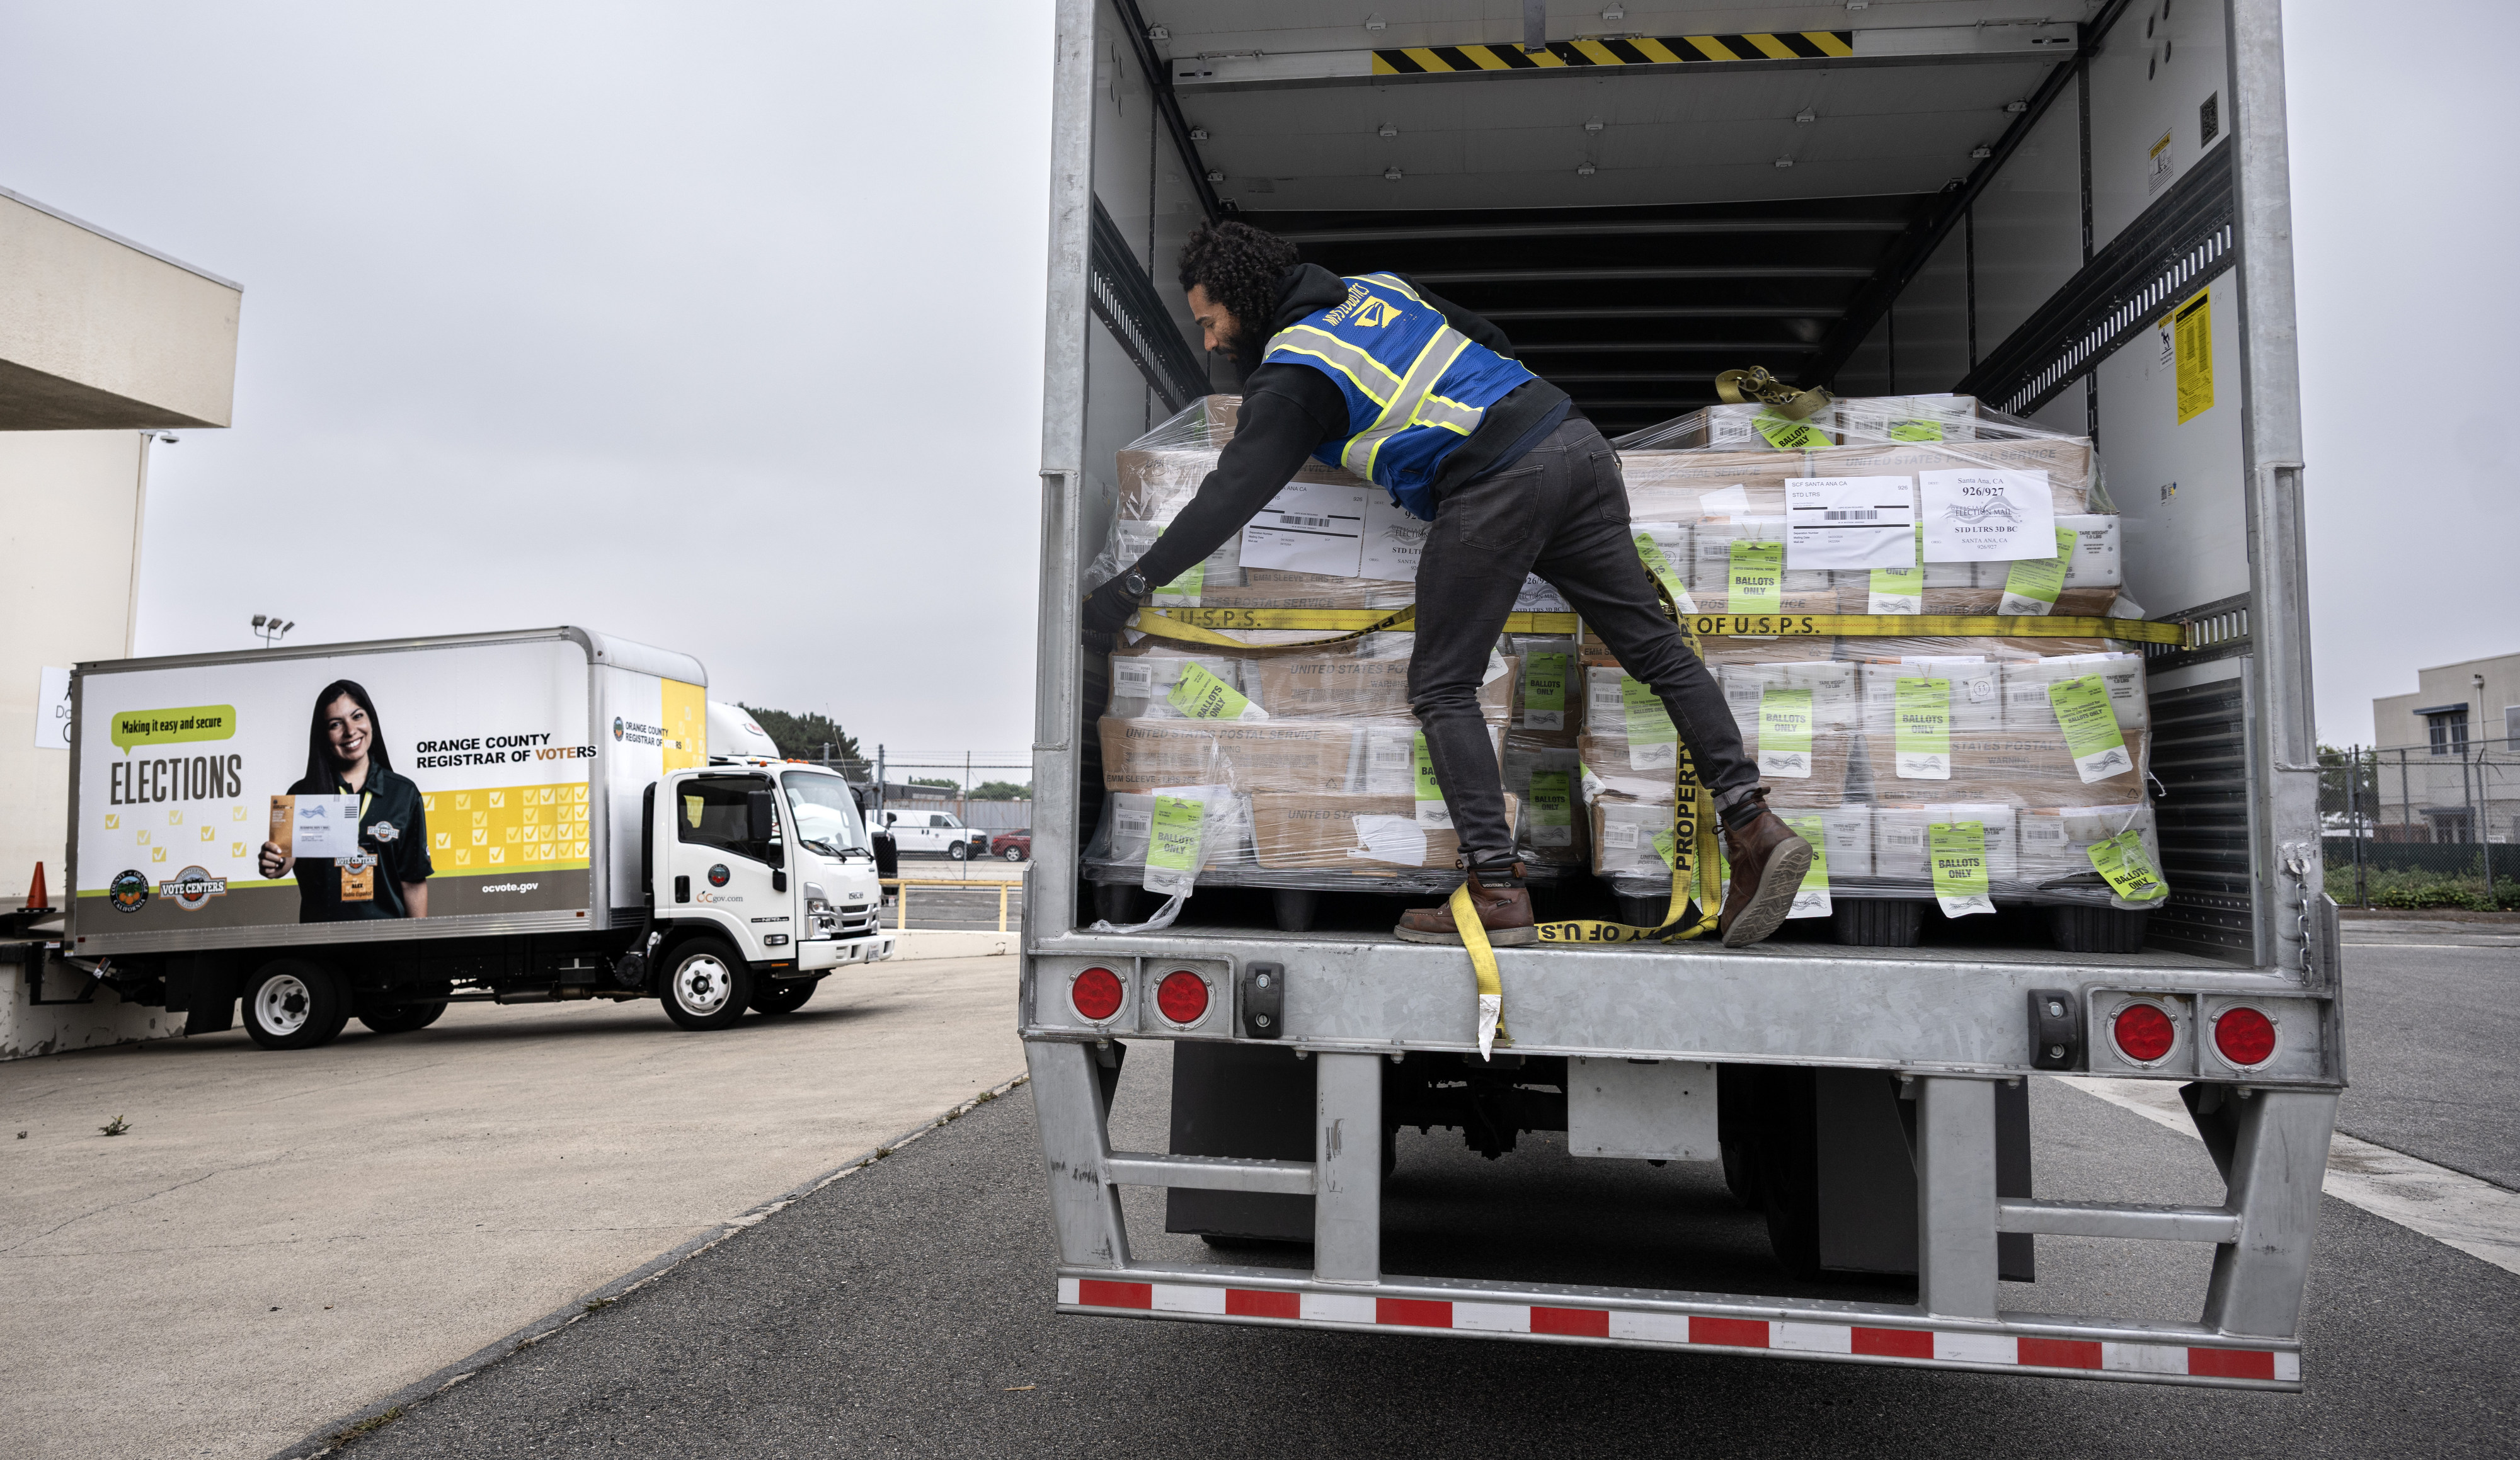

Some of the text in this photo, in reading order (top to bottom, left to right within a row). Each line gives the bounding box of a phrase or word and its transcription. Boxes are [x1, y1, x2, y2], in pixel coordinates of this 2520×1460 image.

[1778, 425, 1810, 447] BALLOTS
[1791, 435, 1810, 448] ONLY
[1845, 449, 2056, 467] UNITED STATES SERVICE
[1714, 466, 1761, 477] SERVICE
[1962, 487, 2004, 496] 926/927
[1273, 574, 1303, 583] SLEEVE
[1736, 576, 1775, 586] BALLOTS
[1743, 586, 1766, 595] ONLY
[1234, 597, 1335, 608] POSTAL SERVICE
[1179, 610, 1262, 627] U.S.P.S.
[1697, 617, 1820, 634] OF U.S.P.S.
[1291, 664, 1383, 674] UNITED STATES
[1530, 680, 1561, 688] BALLOTS
[1197, 685, 1223, 719] BALLOTS
[1210, 697, 1227, 718] ONLY
[1766, 714, 1806, 723] BALLOTS
[1903, 714, 1943, 724] BALLOTS
[2068, 714, 2089, 723] BALLOTS
[122, 716, 222, 736] Making it easy and secure
[626, 721, 668, 737] ORANGE COUNTY
[1774, 724, 1797, 732] ONLY
[1911, 725, 1934, 734] ONLY
[1126, 728, 1321, 740] UNITED STATES POSTAL SERVICE
[416, 733, 551, 753] ORANGE COUNTY
[626, 733, 682, 750] REGISTRAR OF VOTERS
[1952, 741, 2058, 751] STATES POSTAL
[1203, 745, 1240, 753] WARNING
[416, 745, 597, 768] REGISTRAR OF VOTERS
[110, 754, 242, 805] ELECTIONS
[1125, 775, 1155, 783] SLEEVE
[1676, 741, 1696, 871] PROPERTY
[1288, 810, 1330, 819] UNITED
[1158, 832, 1194, 845] BALLOTS
[1164, 843, 1186, 855] ONLY
[1939, 858, 1979, 869] BALLOTS
[1949, 869, 1972, 879] ONLY
[2113, 866, 2150, 886] BALLOTS
[111, 871, 148, 896] COUNTY ORANGE
[162, 881, 224, 895] VOTE CENTERS
[482, 882, 539, 894] ocvote.gov
[2128, 877, 2149, 890] ONLY
[696, 893, 743, 903] OCgov.com
[113, 899, 146, 913] CALIFORNIA
[1589, 924, 1619, 942] OF
